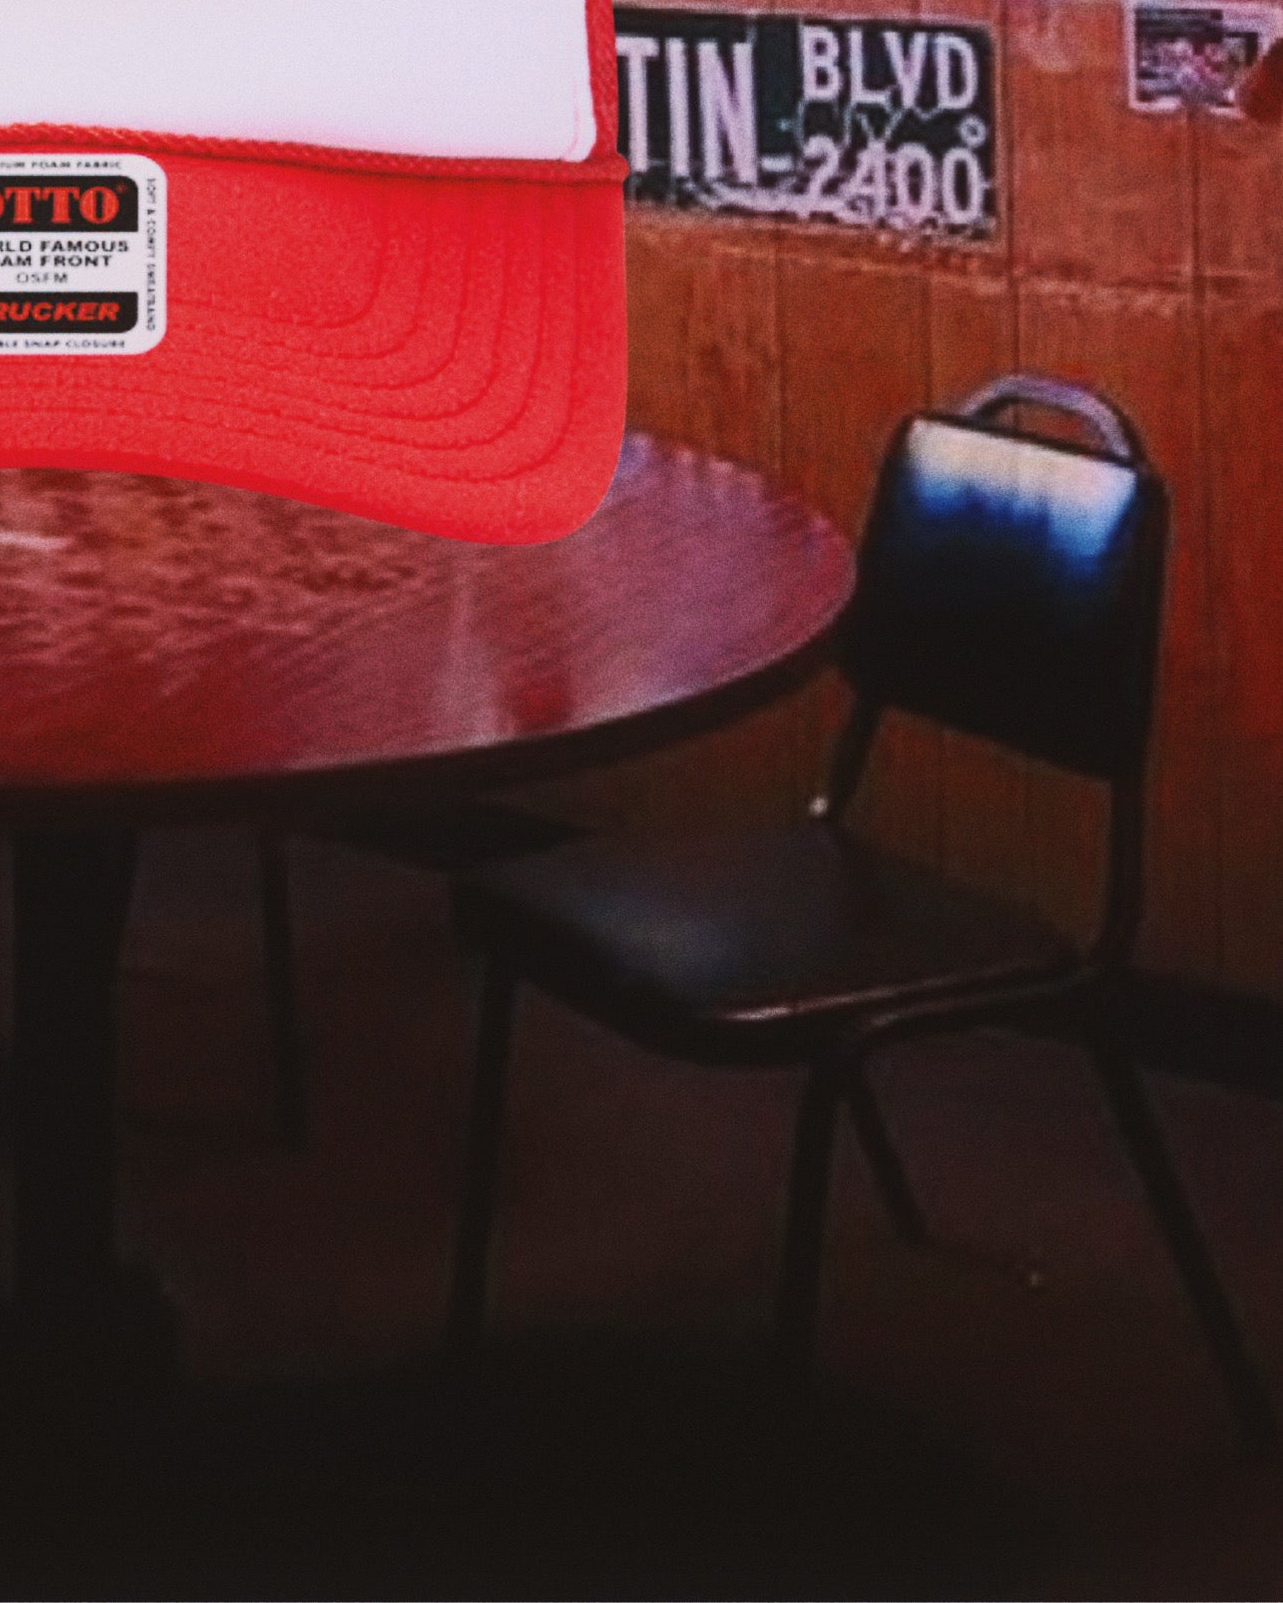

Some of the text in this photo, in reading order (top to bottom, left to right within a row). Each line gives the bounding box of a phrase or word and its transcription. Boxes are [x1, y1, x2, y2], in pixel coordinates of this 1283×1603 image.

[802, 24, 981, 112] BLVD
[803, 135, 985, 227] 2400
[40, 240, 130, 253] FAMOUS
[40, 255, 113, 268] FRONT
[16, 272, 69, 284] OSFM
